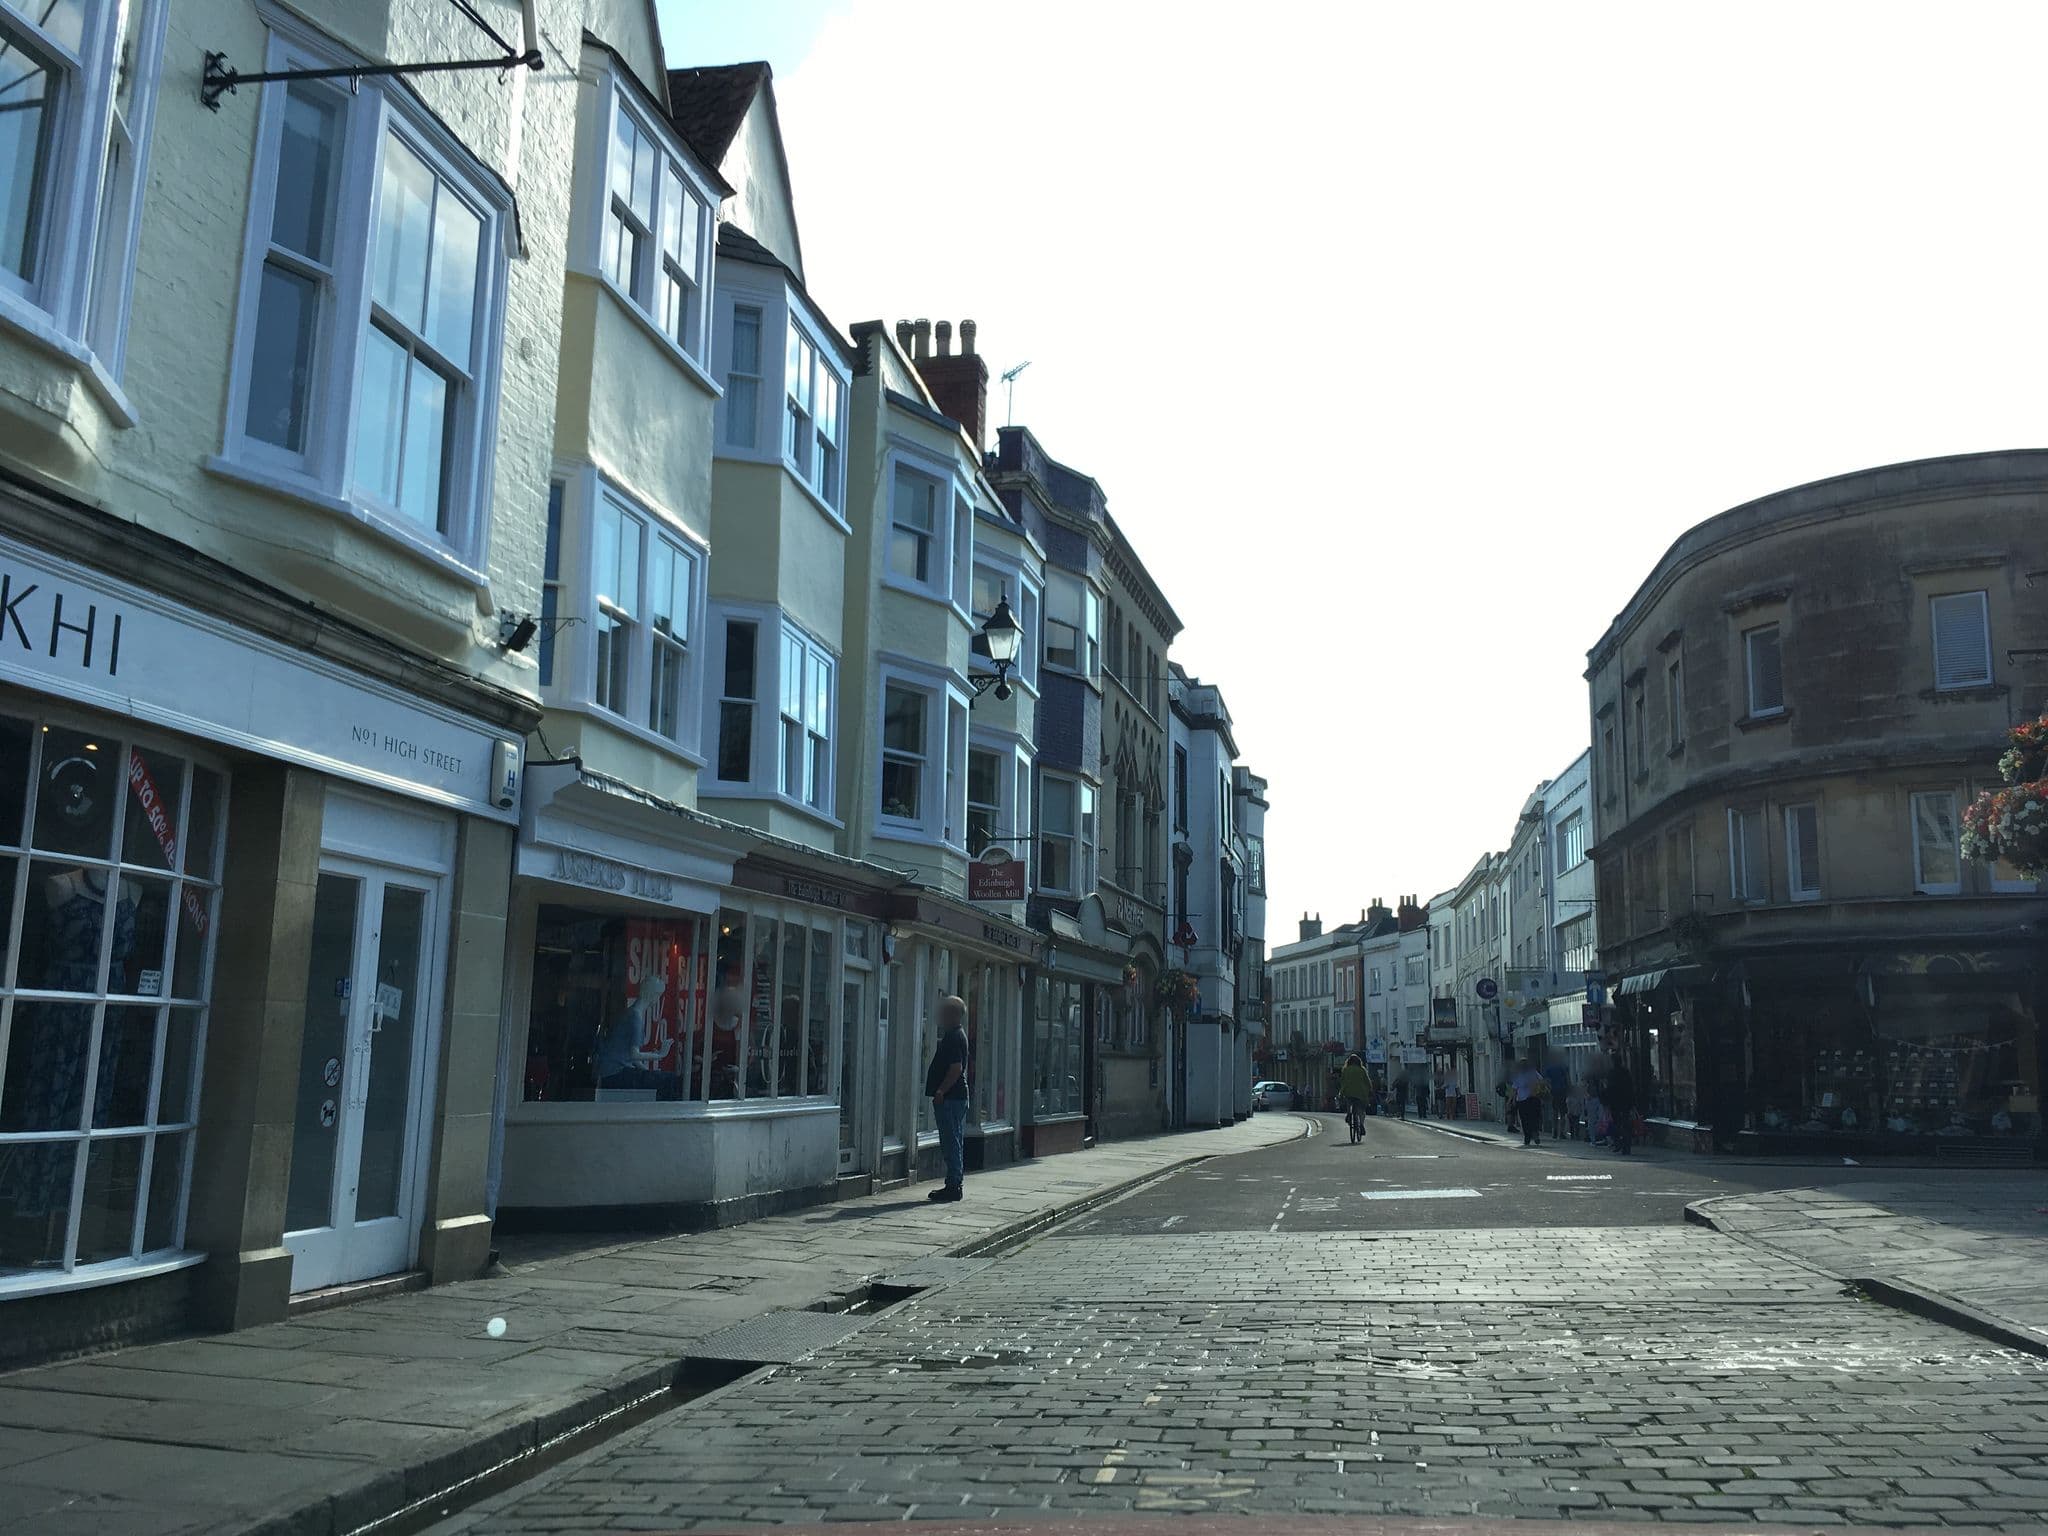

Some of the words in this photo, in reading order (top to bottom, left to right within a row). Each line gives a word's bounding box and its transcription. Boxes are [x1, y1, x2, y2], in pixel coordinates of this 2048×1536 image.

[384, 735, 417, 761] HIGH
[423, 748, 462, 774] STREET
[129, 756, 145, 783] UP
[139, 780, 154, 808] TO
[149, 805, 169, 846] 50%
[978, 878, 1015, 889] Edinburgh
[991, 868, 1003, 877] The
[973, 889, 1003, 898] Woollen
[1005, 889, 1020, 898] Mill
[630, 937, 669, 985] SALE
